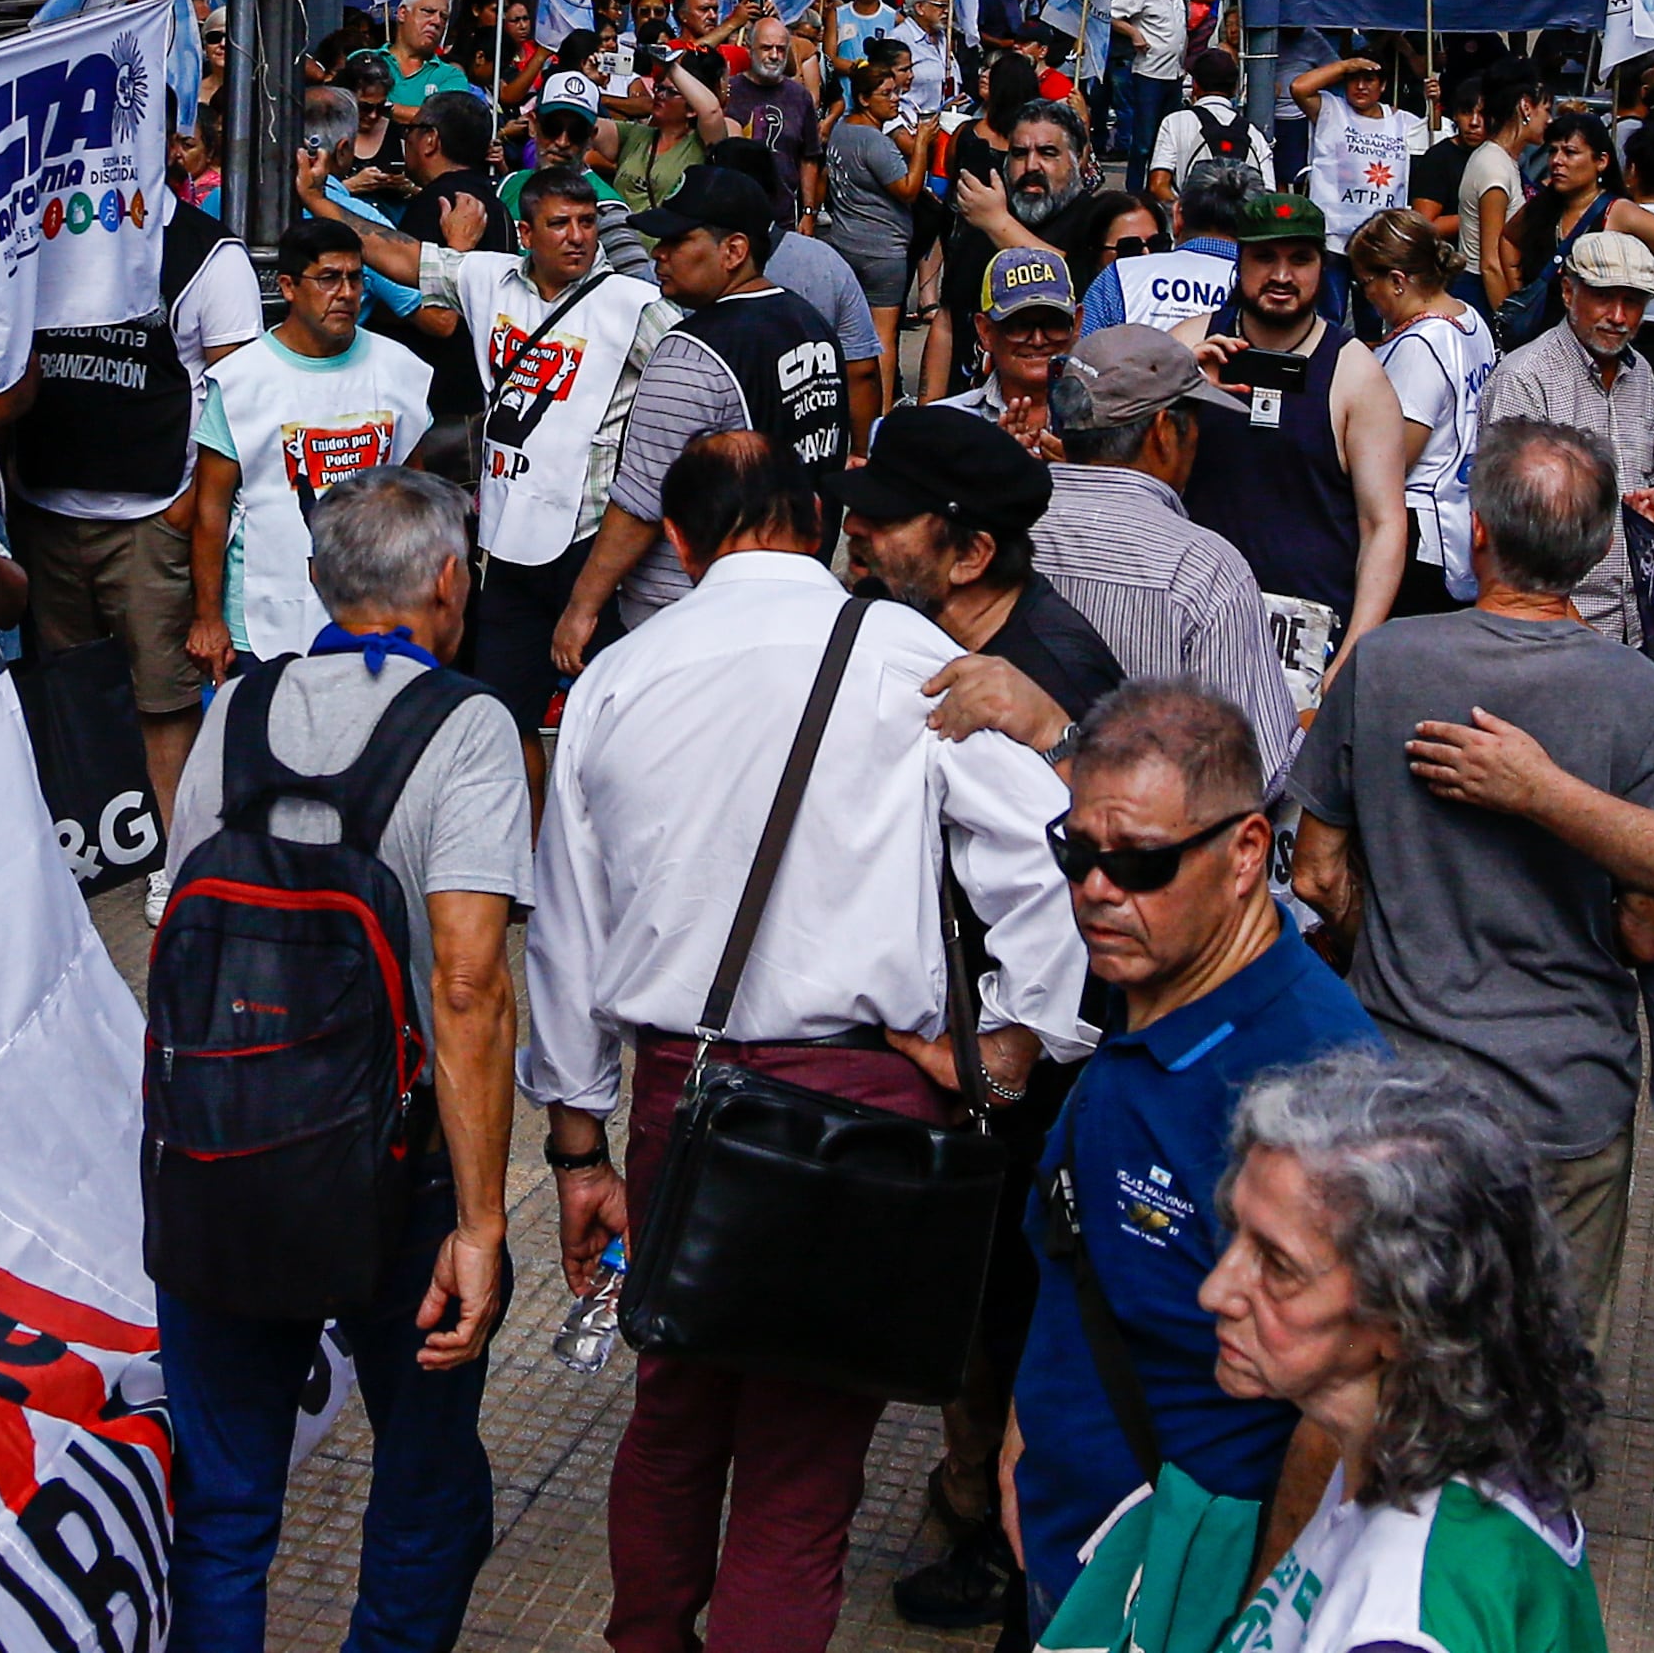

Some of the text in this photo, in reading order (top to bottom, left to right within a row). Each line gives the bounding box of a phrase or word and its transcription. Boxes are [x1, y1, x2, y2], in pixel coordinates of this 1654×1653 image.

[1005, 261, 1057, 290] BOCA
[1151, 277, 1227, 308] CONA
[39, 351, 148, 391] RGANIZACIÓN
[777, 341, 837, 392] CTA
[351, 433, 373, 449] por
[325, 451, 362, 468] Poder
